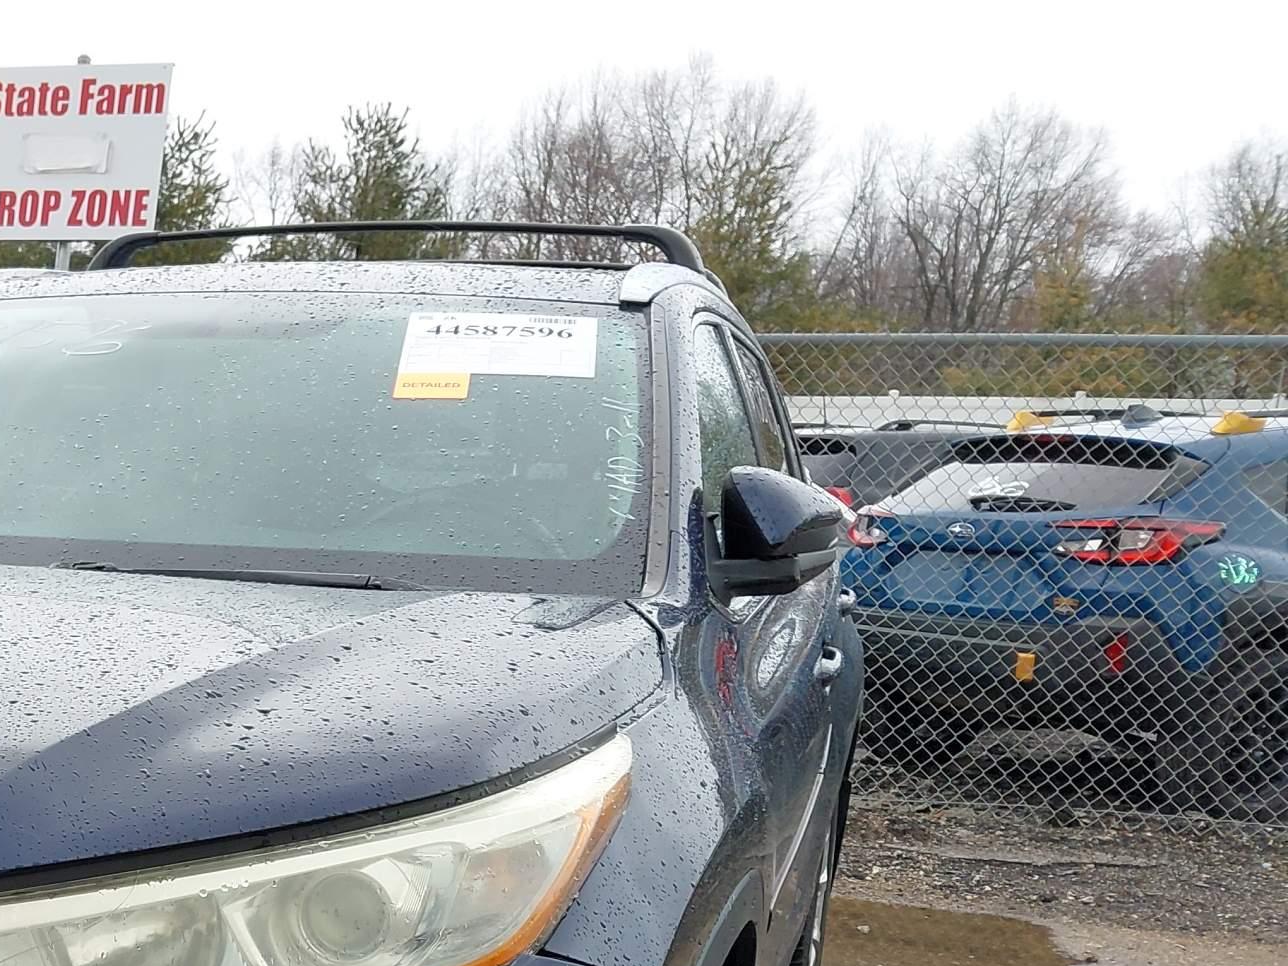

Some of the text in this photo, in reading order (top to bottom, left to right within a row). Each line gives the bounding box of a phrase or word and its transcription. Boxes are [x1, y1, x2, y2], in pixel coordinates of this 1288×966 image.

[78, 77, 167, 116] Farm
[66, 189, 151, 227] ZONE
[426, 324, 573, 339] 44587596
